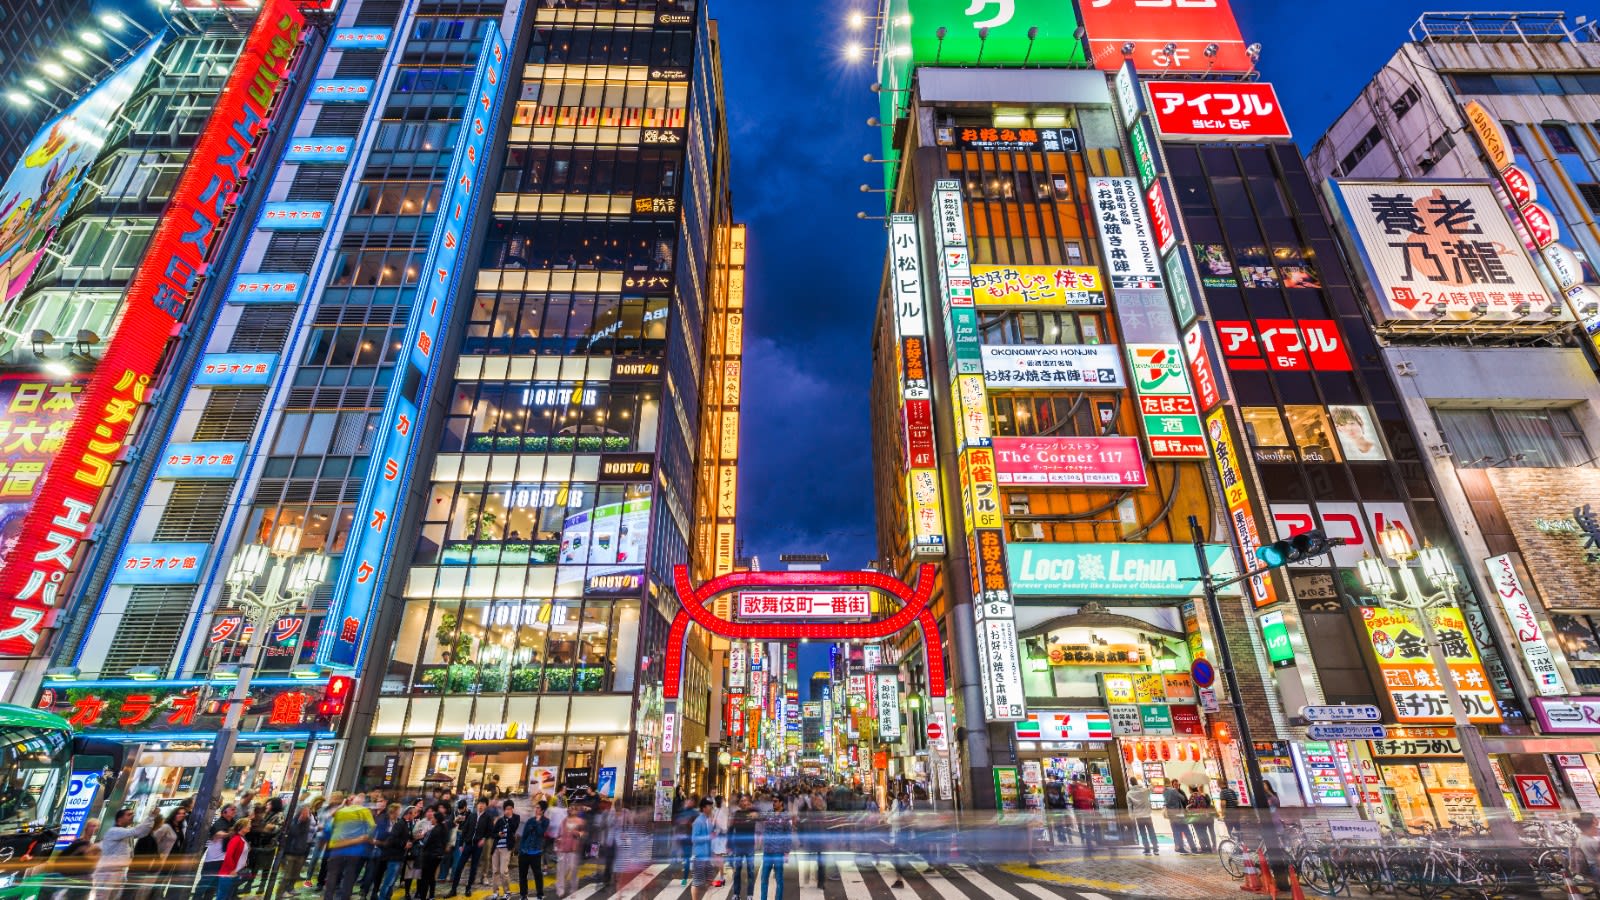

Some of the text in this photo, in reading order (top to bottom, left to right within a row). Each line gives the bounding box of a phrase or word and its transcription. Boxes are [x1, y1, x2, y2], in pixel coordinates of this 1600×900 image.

[1155, 92, 1273, 116] アイフル
[1192, 119, 1251, 130] 当ビル 5F
[961, 128, 1038, 142] お好み焼
[1063, 136, 1073, 145] 8F
[291, 144, 346, 154] カラオケ館
[266, 210, 323, 220] カラオケ館
[1367, 193, 1484, 236] 養老
[1097, 188, 1131, 273] お好み焼き本陣
[1124, 179, 1147, 237] OKONOMIYAKI
[1138, 240, 1156, 273] HONJIN
[1388, 240, 1516, 285] 乃瀧
[896, 233, 920, 318] 小松ビル
[971, 268, 1020, 288] お好み
[1053, 269, 1095, 289] 焼き
[236, 282, 297, 292] カラオケ館
[988, 274, 1046, 298] もんじゃ
[1021, 285, 1056, 303] たこ
[1089, 293, 1104, 304] 7F
[1392, 288, 1414, 301] B1
[1421, 291, 1546, 307] 24時間営業中
[1220, 327, 1338, 352] アイフル
[906, 338, 923, 380] お好み焼
[990, 348, 1098, 356] OKONOMIYAKI HONJIN
[962, 362, 977, 371] 3F
[1277, 356, 1297, 367] 5F
[204, 363, 268, 375] カラオケ館
[616, 363, 659, 375] DOUTOR
[984, 369, 1082, 382] お好み焼き本陣
[1099, 371, 1116, 382] 2F
[1194, 356, 1213, 397] アコム
[8, 382, 83, 414] 日本
[522, 387, 597, 406] DOUTOR
[910, 388, 923, 397] 8F
[1205, 394, 1215, 405] 3F
[1143, 397, 1193, 412] たばこ
[74, 369, 151, 488] パチンコ
[1160, 417, 1185, 433] 酒
[912, 430, 927, 438] 117
[1019, 442, 1100, 451] ダイニングレストラン
[1152, 439, 1205, 453] 銀行ATM
[167, 454, 236, 467] カラオケ館
[914, 453, 930, 464] 4F
[998, 451, 1123, 463] The Corner 117
[604, 461, 650, 474] DOUTOR
[969, 450, 996, 513] 麻雀ブル
[1124, 471, 1140, 482] 4F
[503, 487, 584, 508] DOUTOR
[721, 477, 733, 516] すずや
[1230, 490, 1243, 503] 2F
[981, 514, 995, 525] 6F
[339, 414, 411, 645] カラオケ館
[980, 531, 1005, 590] お好み焼
[1234, 511, 1266, 599] 東京チカラめし
[124, 556, 198, 570] カラオケ館
[0, 497, 94, 645] エスパス
[590, 575, 639, 588] DOUTOR
[743, 596, 866, 614] 歌舞伎町一番街
[990, 603, 1007, 615] 8F
[481, 599, 567, 626] DOUTOR
[1362, 608, 1375, 619] 2F
[1268, 634, 1287, 649] レイク
[990, 630, 1008, 706] お好み焼き本陣
[1532, 658, 1552, 667] TAX
[1534, 664, 1555, 673] FREE
[1011, 705, 1022, 715] 2F
[1391, 693, 1409, 716] 東京
[463, 721, 528, 741] DOUTOR
[1375, 739, 1462, 755] 東京 チカラめし
[69, 798, 82, 806] 400
